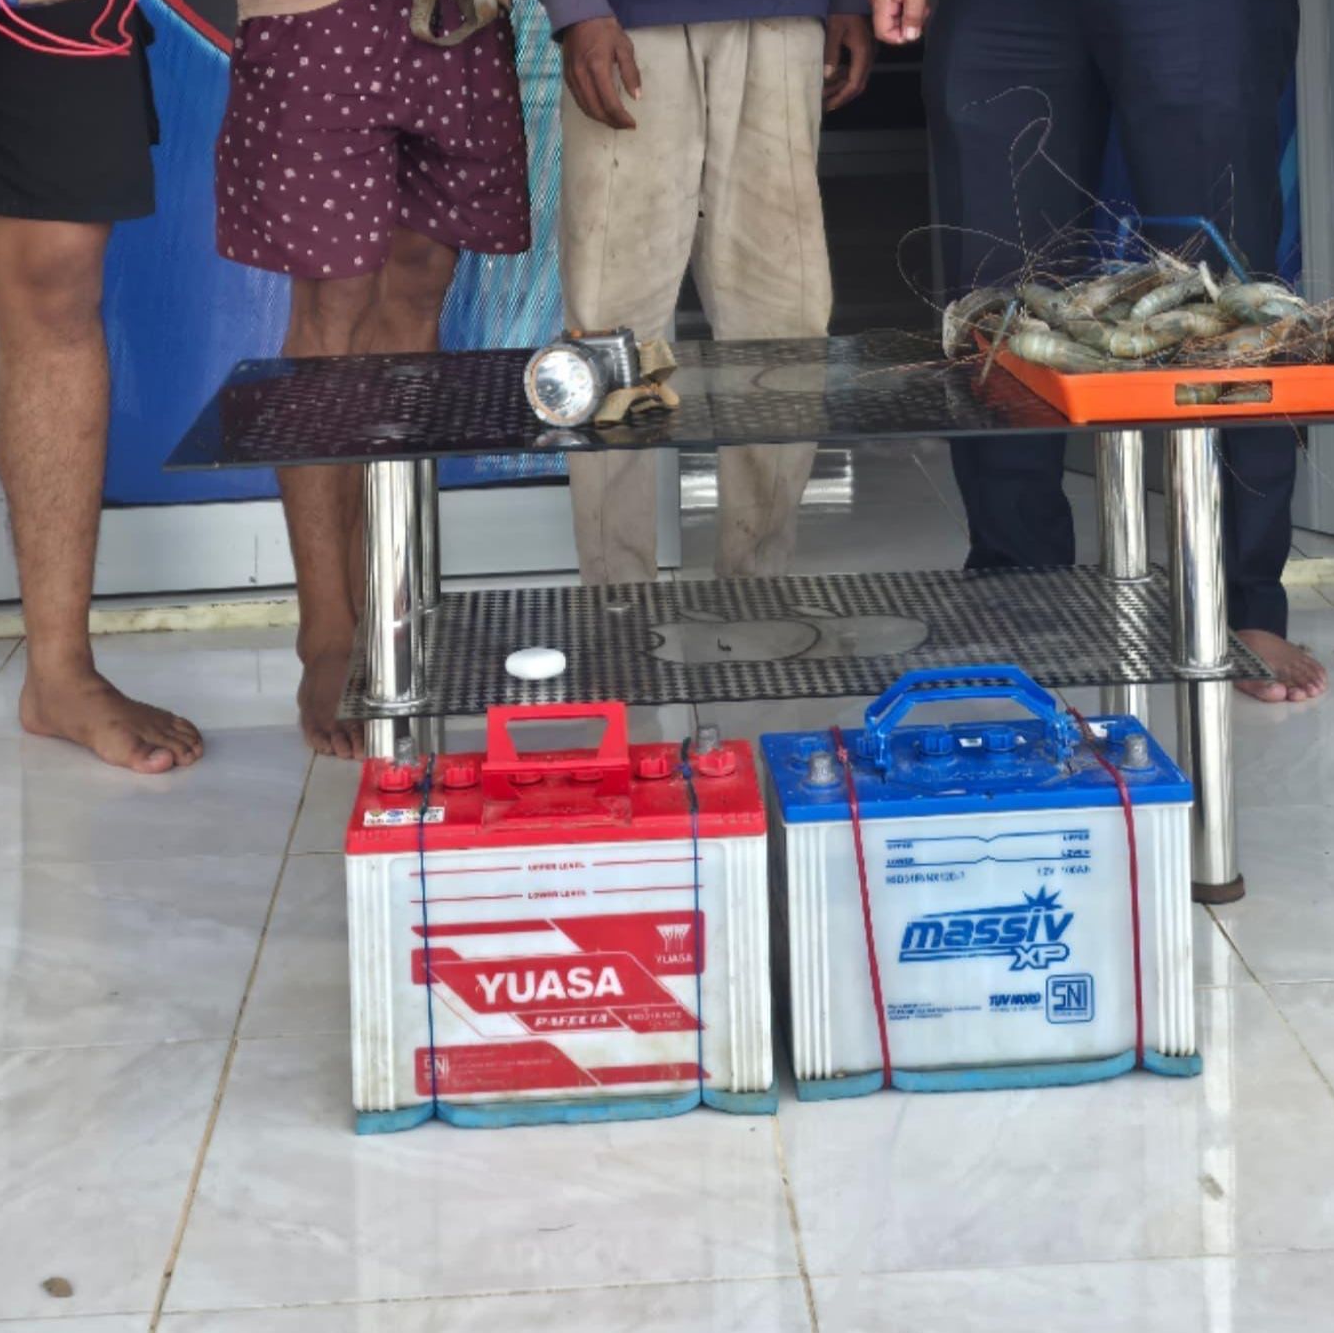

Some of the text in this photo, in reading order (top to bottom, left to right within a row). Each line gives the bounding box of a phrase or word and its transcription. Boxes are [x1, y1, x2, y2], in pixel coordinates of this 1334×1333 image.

[528, 861, 585, 871] UPPER LEVEL
[528, 891, 557, 899] LOWER
[901, 909, 1074, 949] massiv
[655, 953, 693, 964] YUASA
[1009, 942, 1070, 971] XP
[475, 967, 624, 1005] YUASA
[1052, 981, 1088, 1010] SNI
